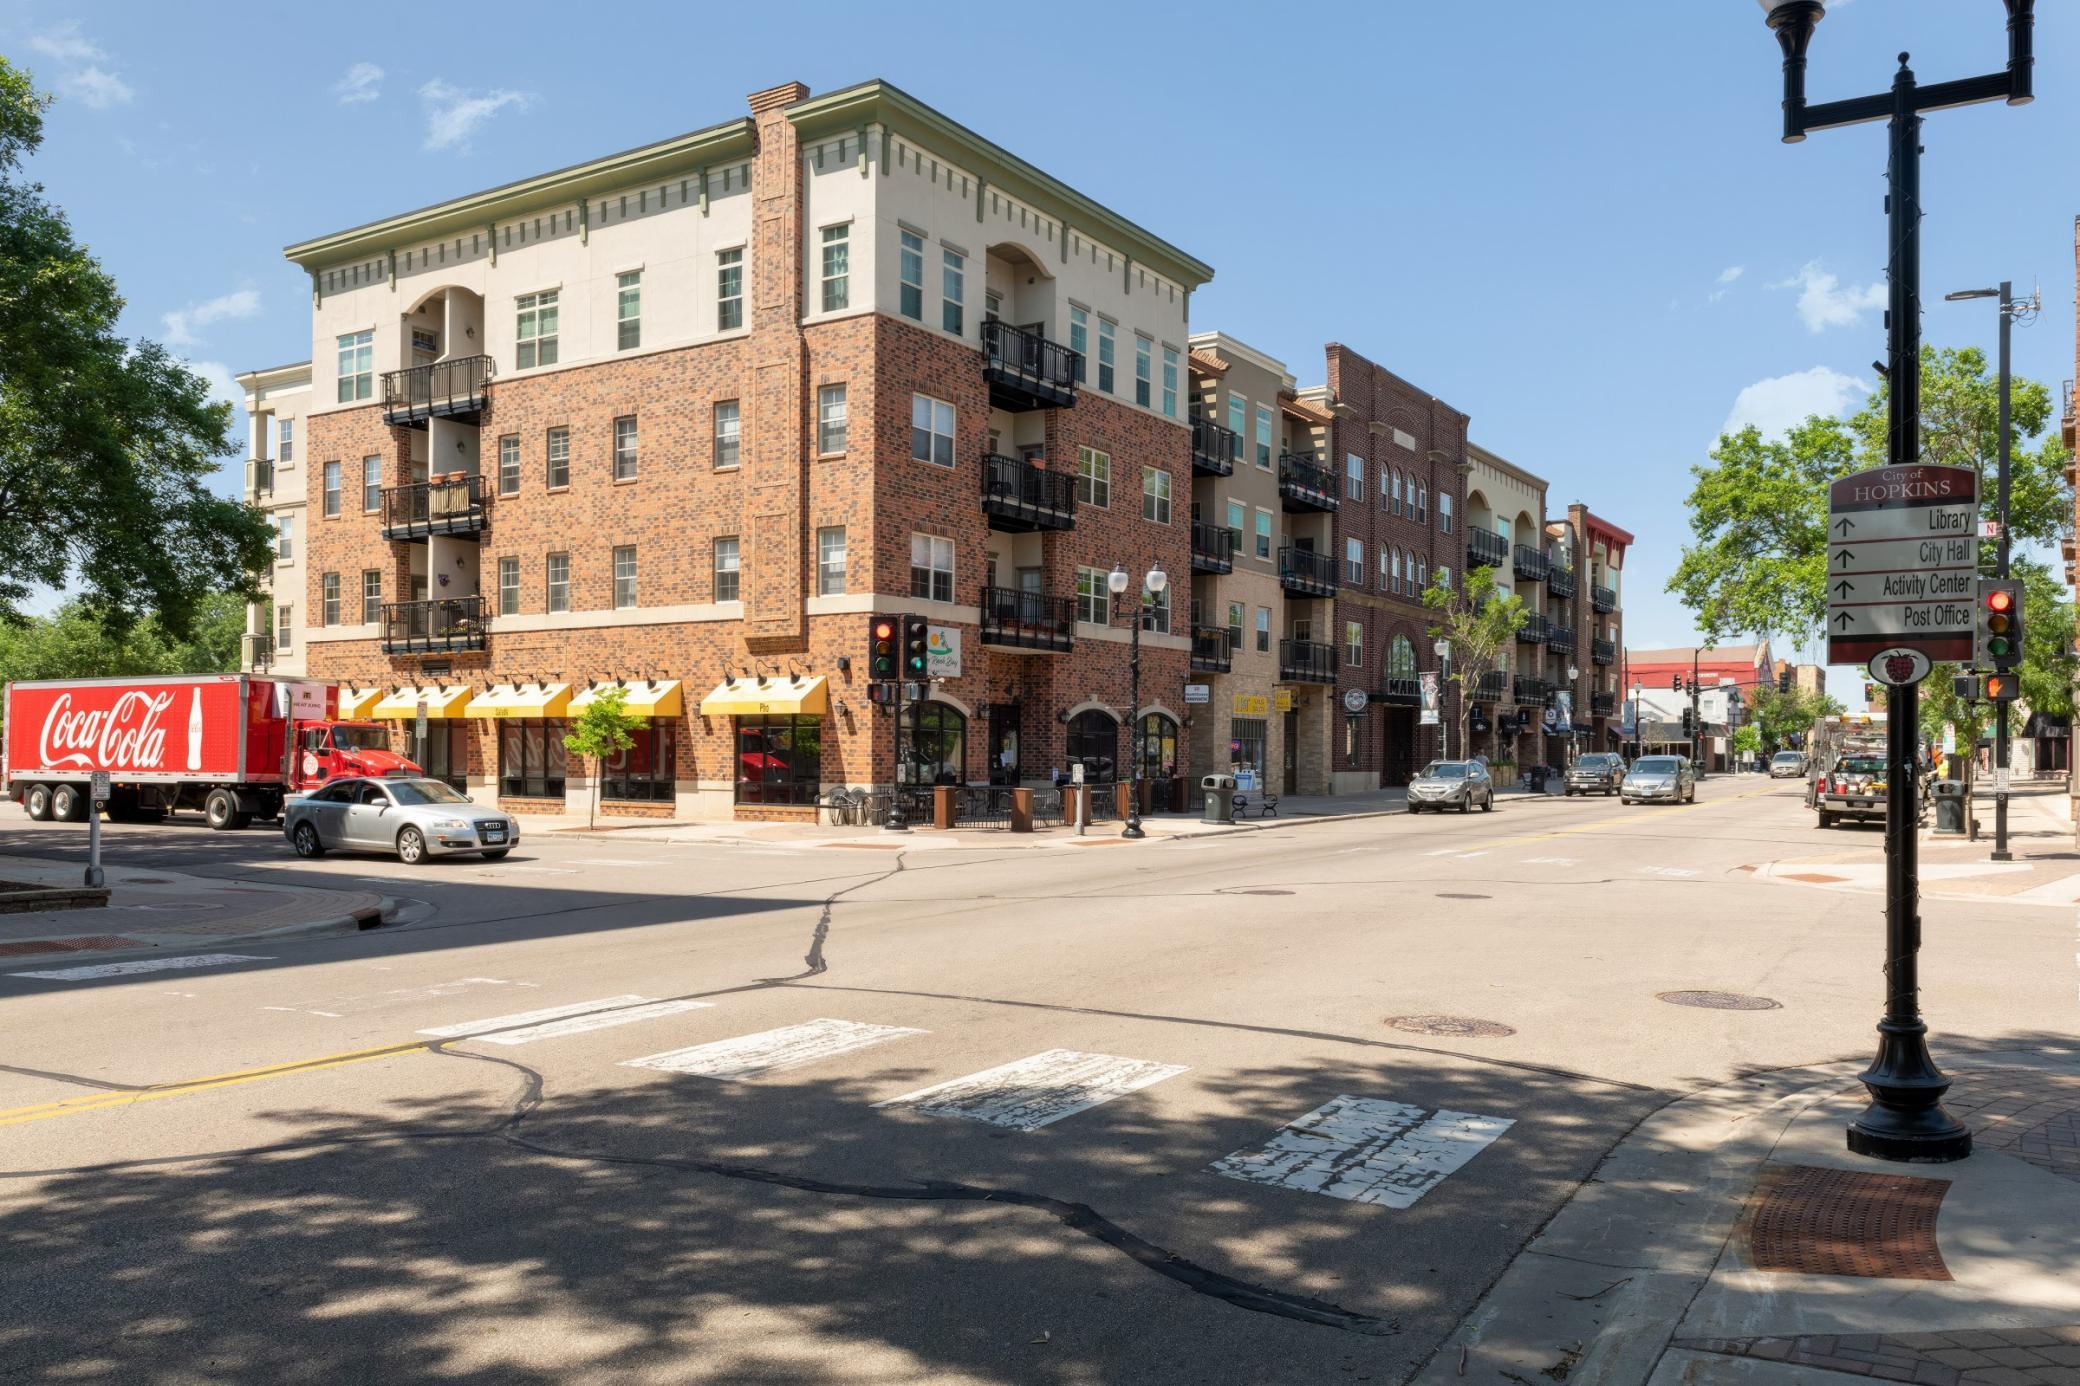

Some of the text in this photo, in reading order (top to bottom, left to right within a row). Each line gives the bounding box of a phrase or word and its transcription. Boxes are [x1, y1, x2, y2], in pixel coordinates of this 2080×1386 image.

[1882, 468, 1923, 481] City of
[1854, 480, 1951, 502] HOPKINS
[1929, 509, 1971, 533] Library
[1919, 540, 1970, 566] City Hall
[1883, 573, 1970, 599] Activity Center
[1904, 604, 1970, 627] Post Office
[40, 690, 176, 768] Coca-Cola
